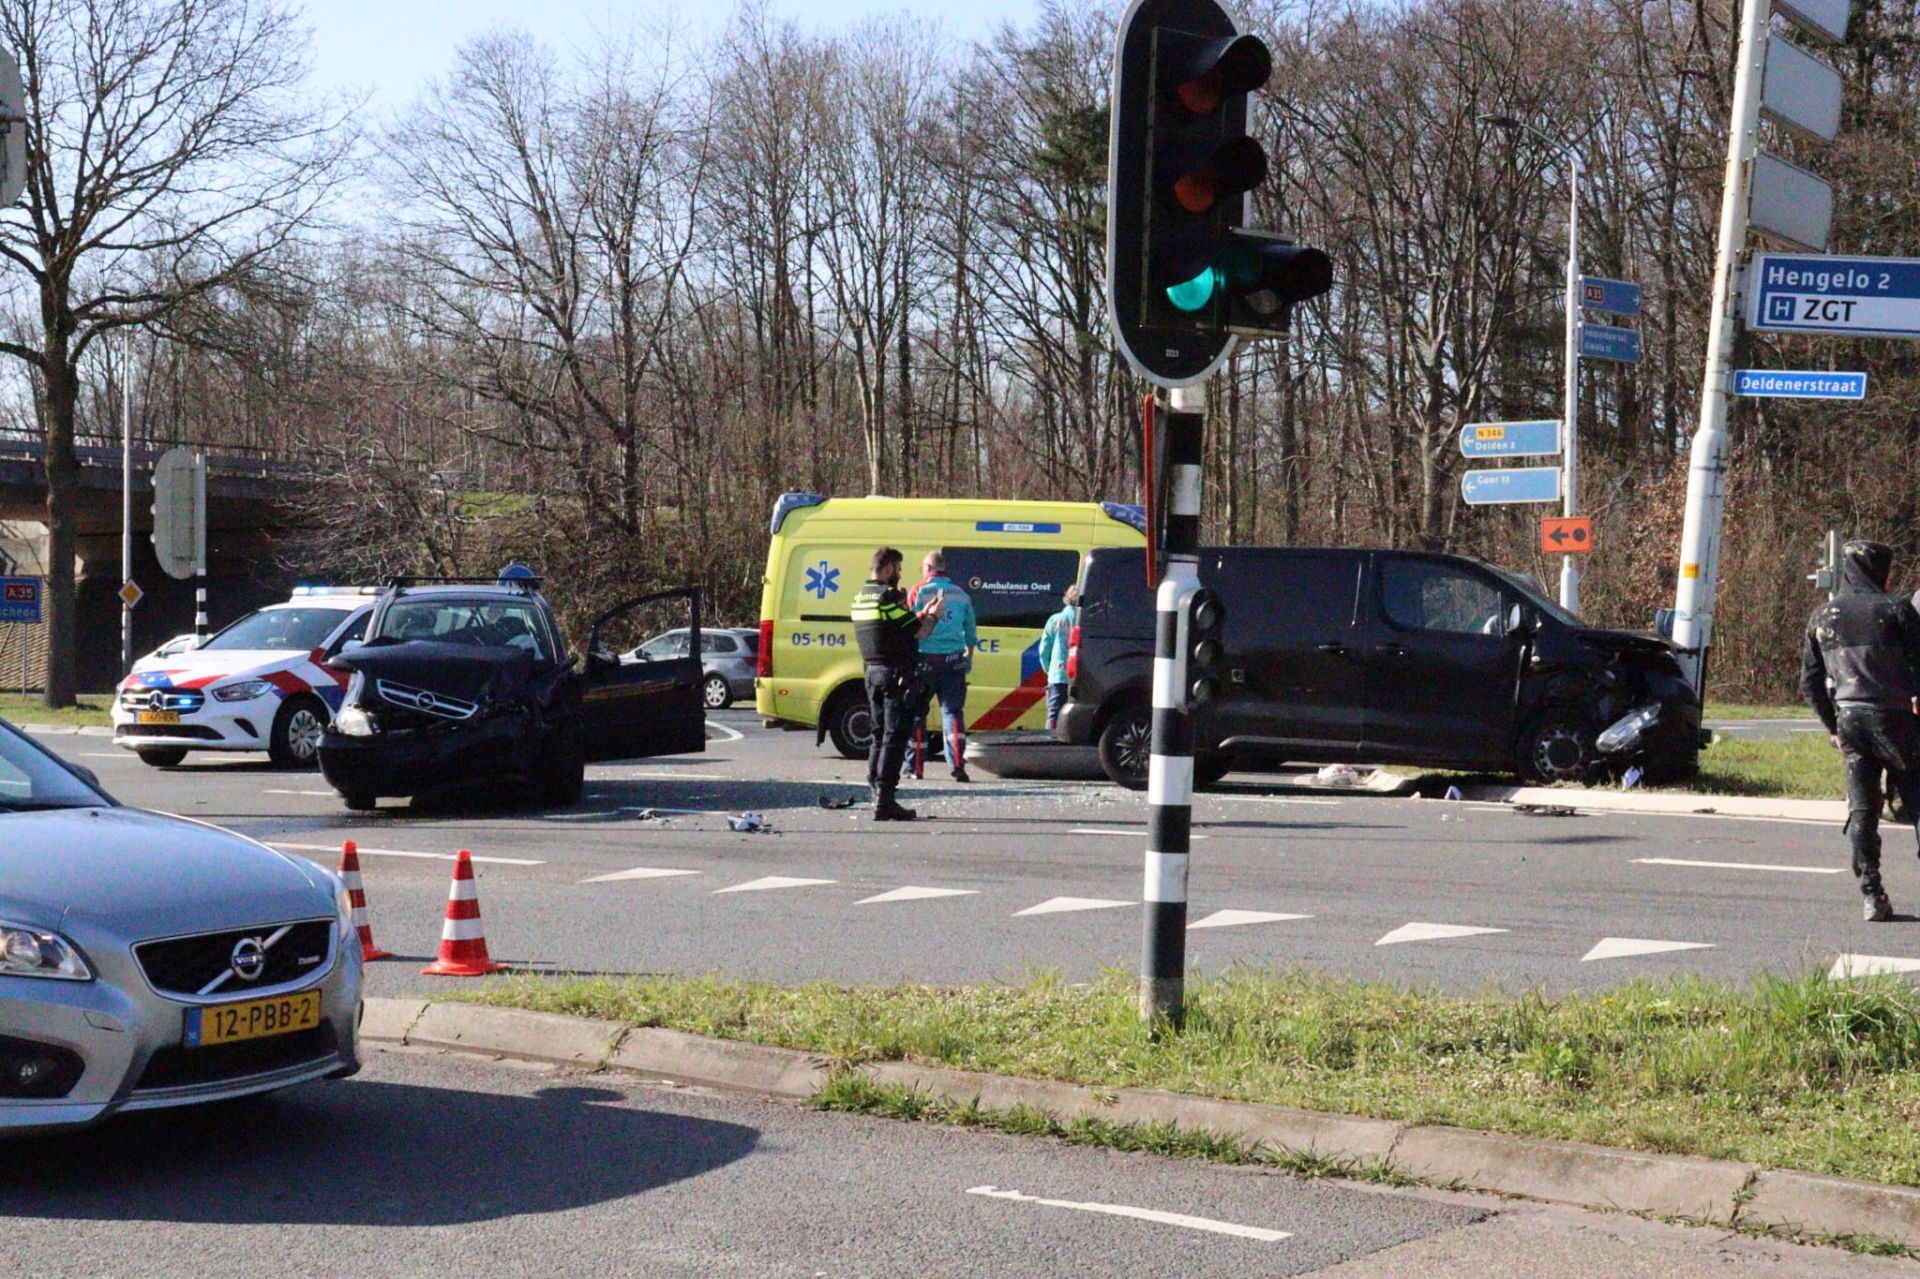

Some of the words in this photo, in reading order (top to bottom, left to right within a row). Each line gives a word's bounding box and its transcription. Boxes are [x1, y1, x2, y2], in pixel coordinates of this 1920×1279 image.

[1768, 266, 1869, 291] Hengelo
[1877, 273, 1891, 289] 2
[1775, 300, 1790, 317] H
[1803, 298, 1857, 322] ZGT
[1740, 376, 1857, 393] Deldenerstraat
[1475, 441, 1508, 450] Delden
[1508, 441, 1515, 449] 2
[1477, 476, 1499, 485] Goor
[981, 581, 1028, 590] Ambulance
[1030, 582, 1051, 591] Oost
[791, 632, 847, 647] 05-104
[215, 998, 312, 1038] 12-PBB-2
